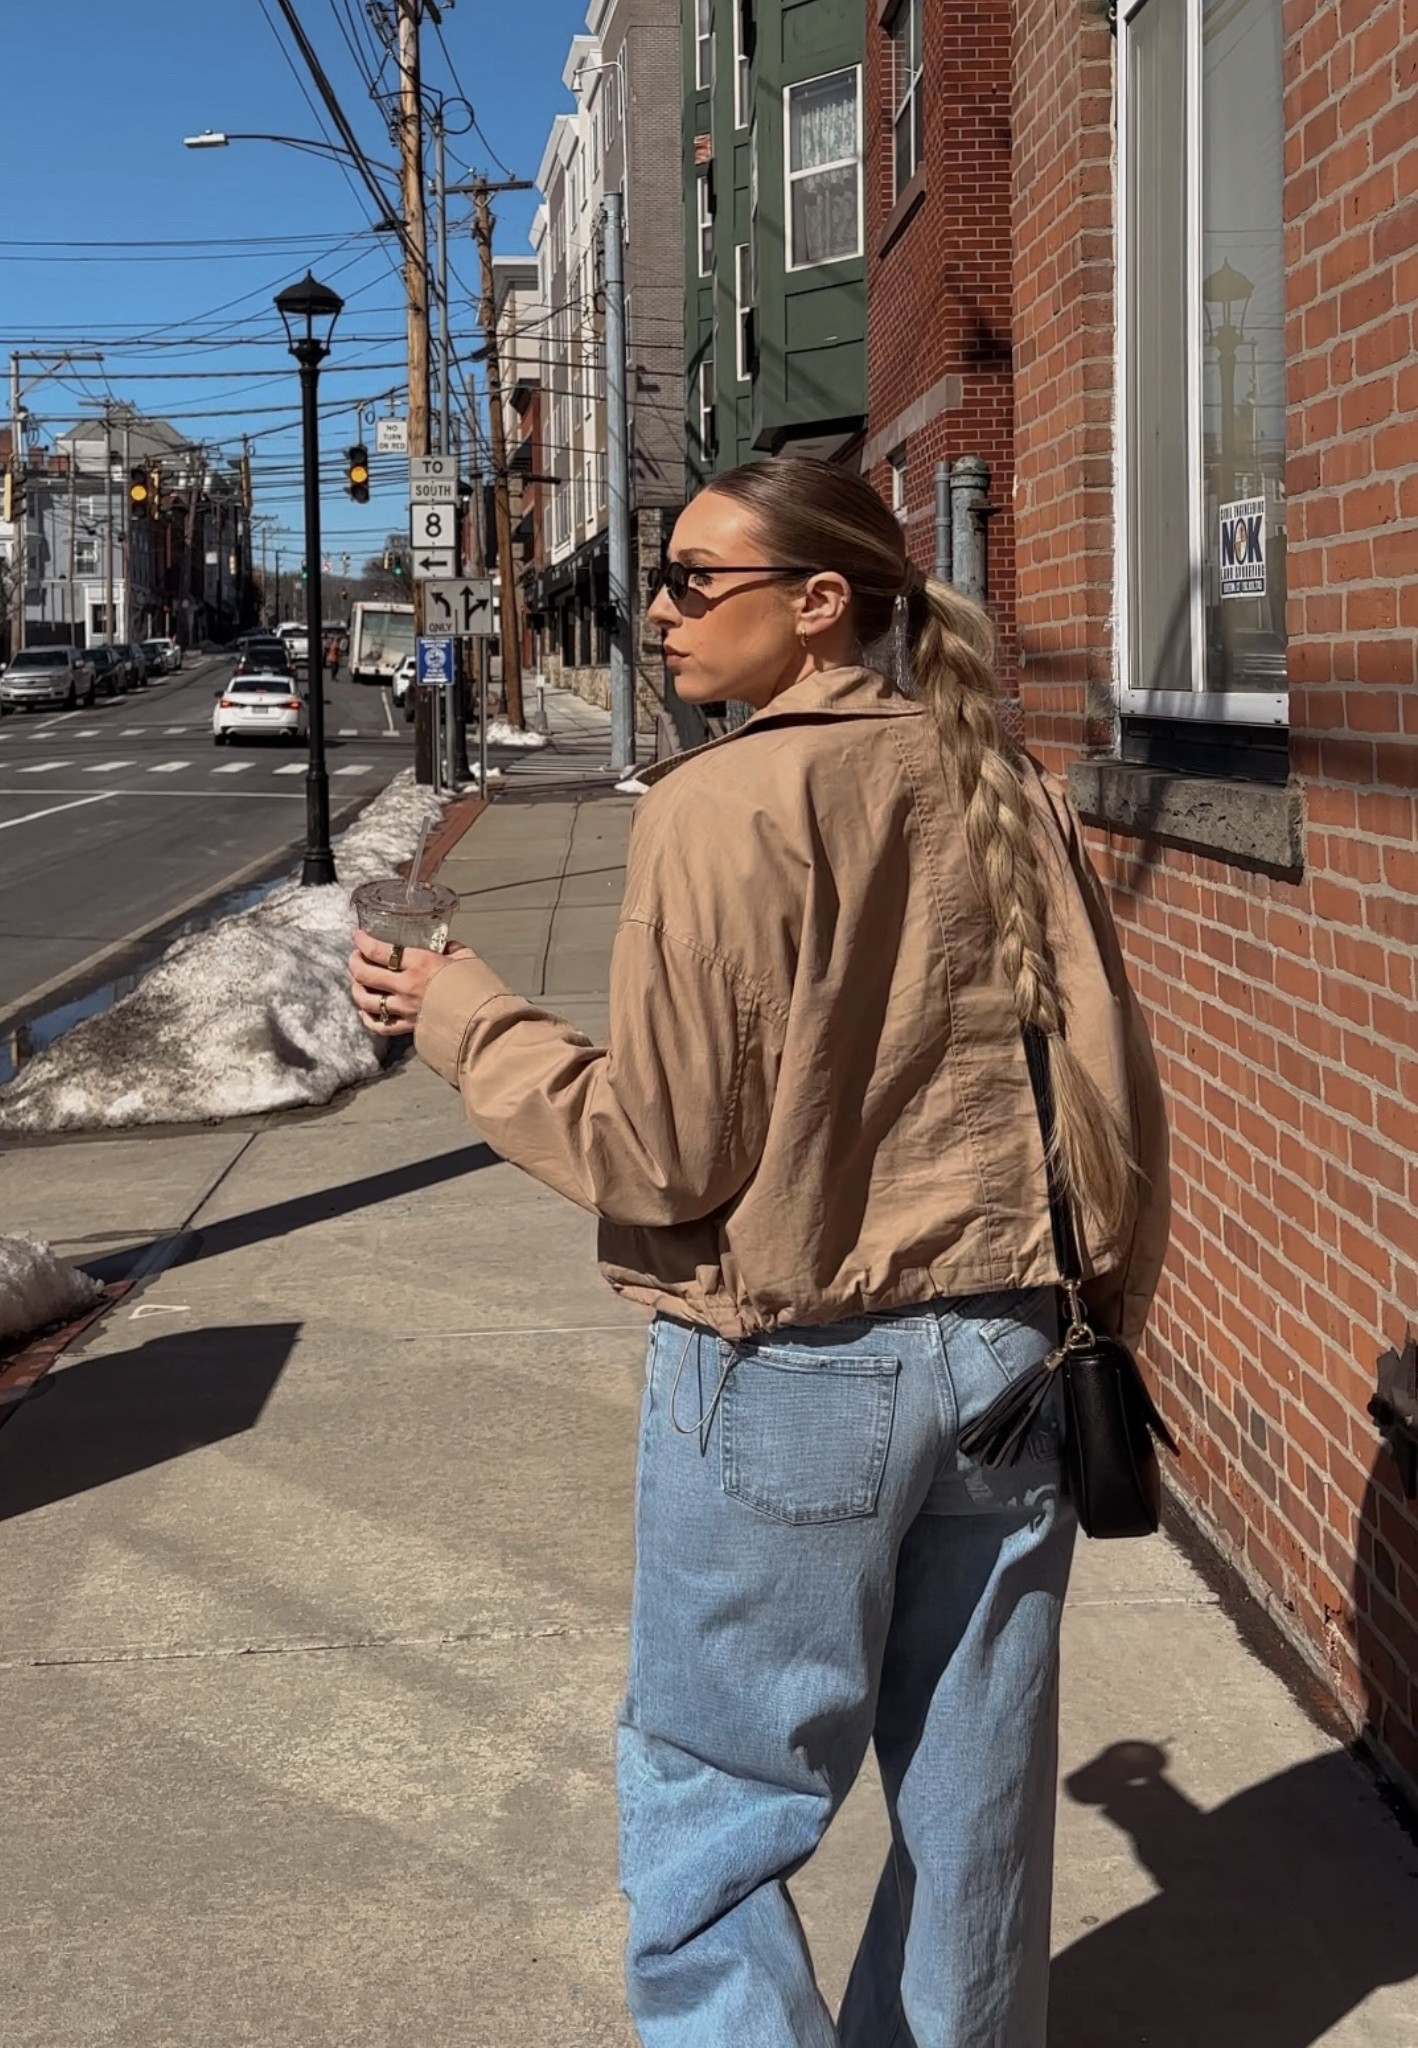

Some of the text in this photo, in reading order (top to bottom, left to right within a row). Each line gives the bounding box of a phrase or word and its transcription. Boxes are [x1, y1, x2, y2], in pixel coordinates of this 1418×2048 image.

[422, 461, 443, 474] TO
[415, 484, 451, 497] SOUTH
[425, 512, 442, 538] 8
[1222, 515, 1263, 567] NOK
[429, 623, 452, 632] ONLY
